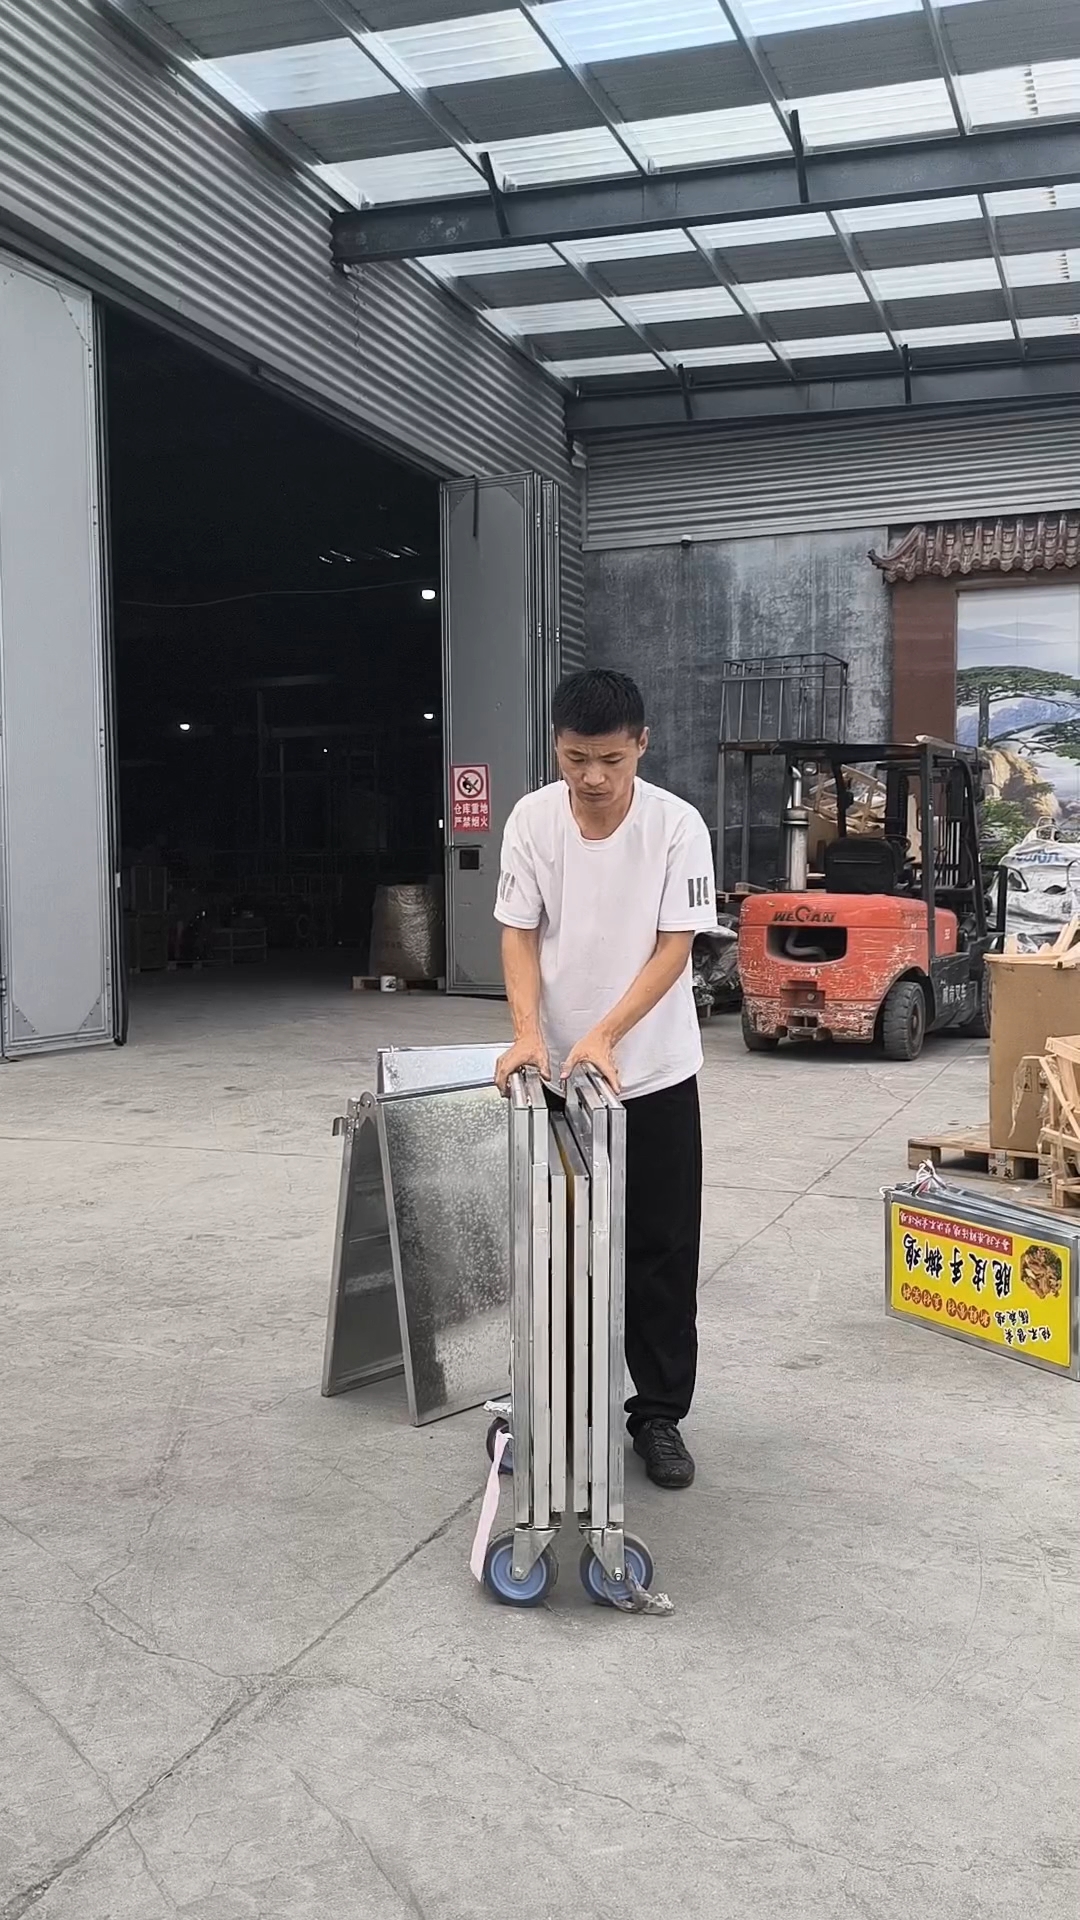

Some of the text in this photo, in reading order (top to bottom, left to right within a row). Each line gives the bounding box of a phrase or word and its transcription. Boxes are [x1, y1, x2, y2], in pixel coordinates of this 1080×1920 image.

[454, 802, 489, 815] 仓库重地
[454, 816, 489, 828] 严禁烟火
[903, 1233, 1013, 1298] 脆皮手撕鸡
[994, 1309, 1029, 1326] 隔夜鸡
[1004, 1327, 1051, 1345] 绝不售卖
